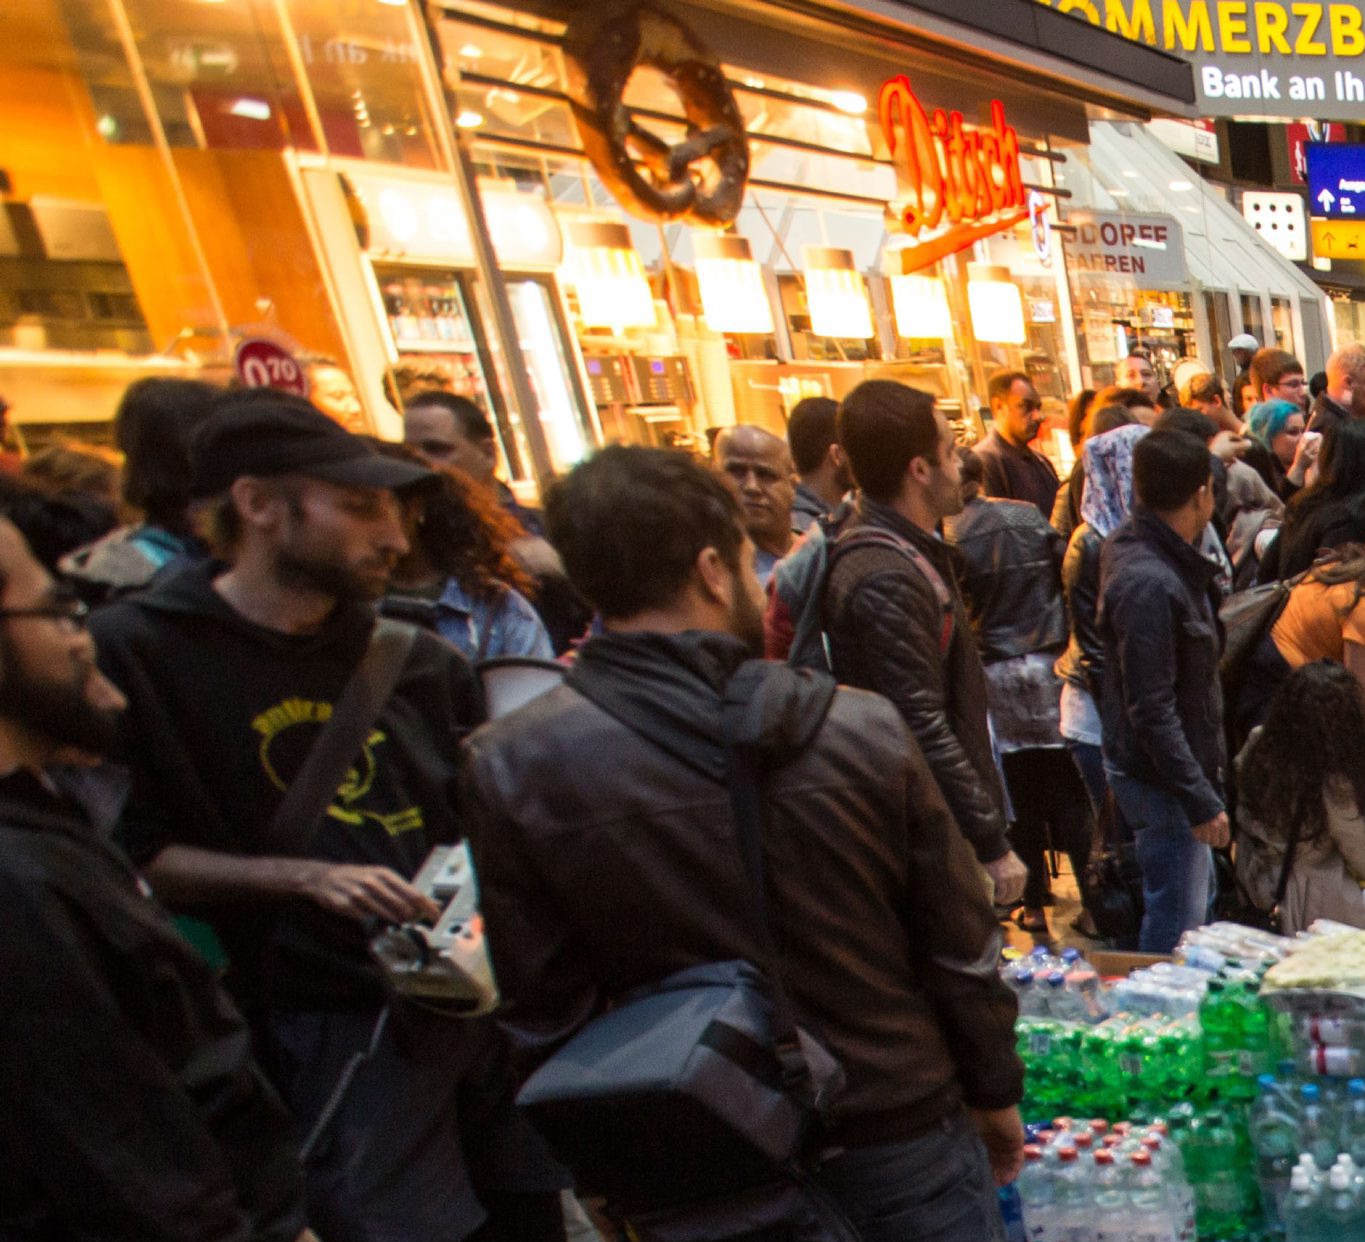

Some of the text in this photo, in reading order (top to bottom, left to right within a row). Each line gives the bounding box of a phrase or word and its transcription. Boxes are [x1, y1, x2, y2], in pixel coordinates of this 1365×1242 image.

[1201, 66, 1281, 99] Bank
[1289, 75, 1325, 100] an
[879, 74, 1026, 238] Ditsch
